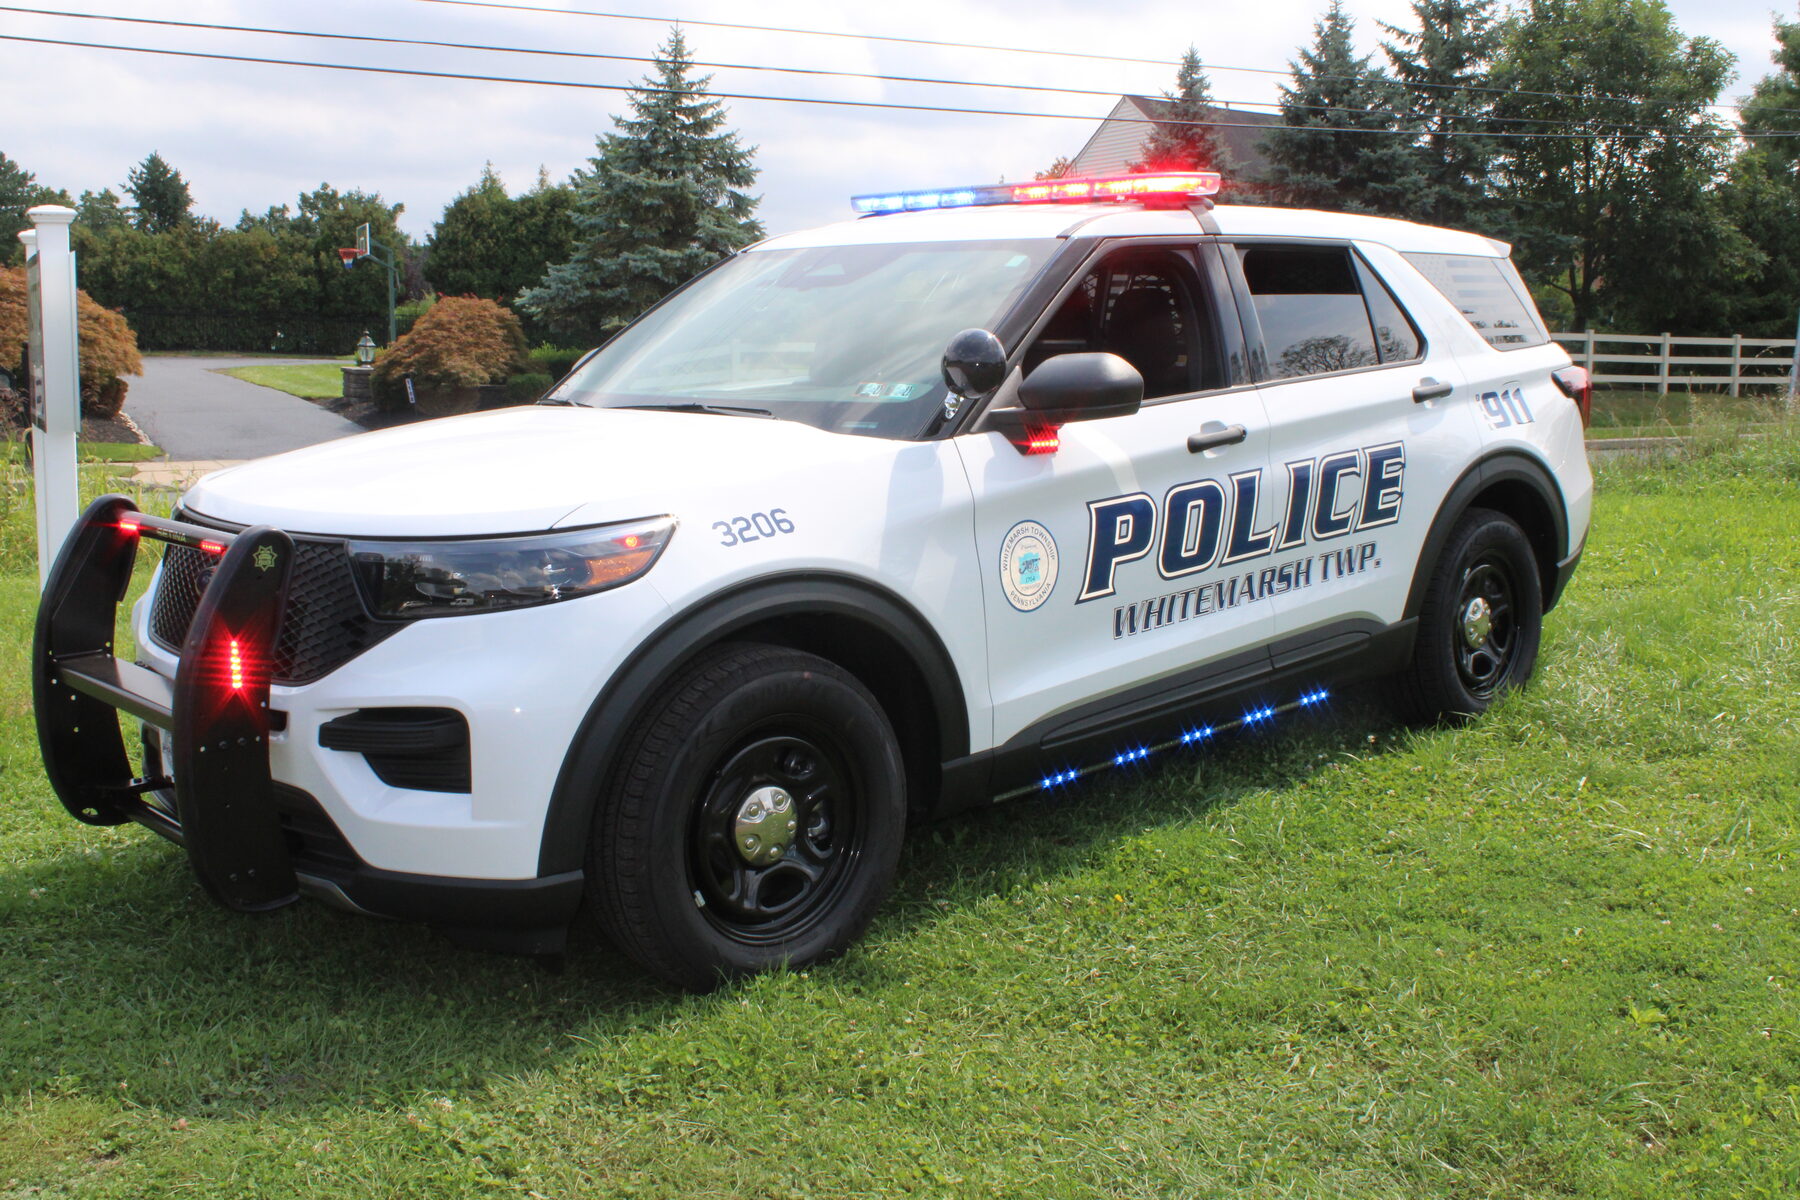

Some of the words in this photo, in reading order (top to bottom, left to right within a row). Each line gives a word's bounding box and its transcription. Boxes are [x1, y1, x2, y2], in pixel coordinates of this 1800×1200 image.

[1481, 388, 1534, 429] 911
[711, 508, 795, 547] 3206
[1074, 440, 1406, 605] POLICE
[1003, 526, 1029, 571] WHITEMARSH
[1031, 527, 1055, 560] TOWNSHIP
[1010, 583, 1050, 606] PENNSYLVANIA
[1113, 556, 1313, 640] WHITEMARSH
[1319, 541, 1382, 584] TWP.
